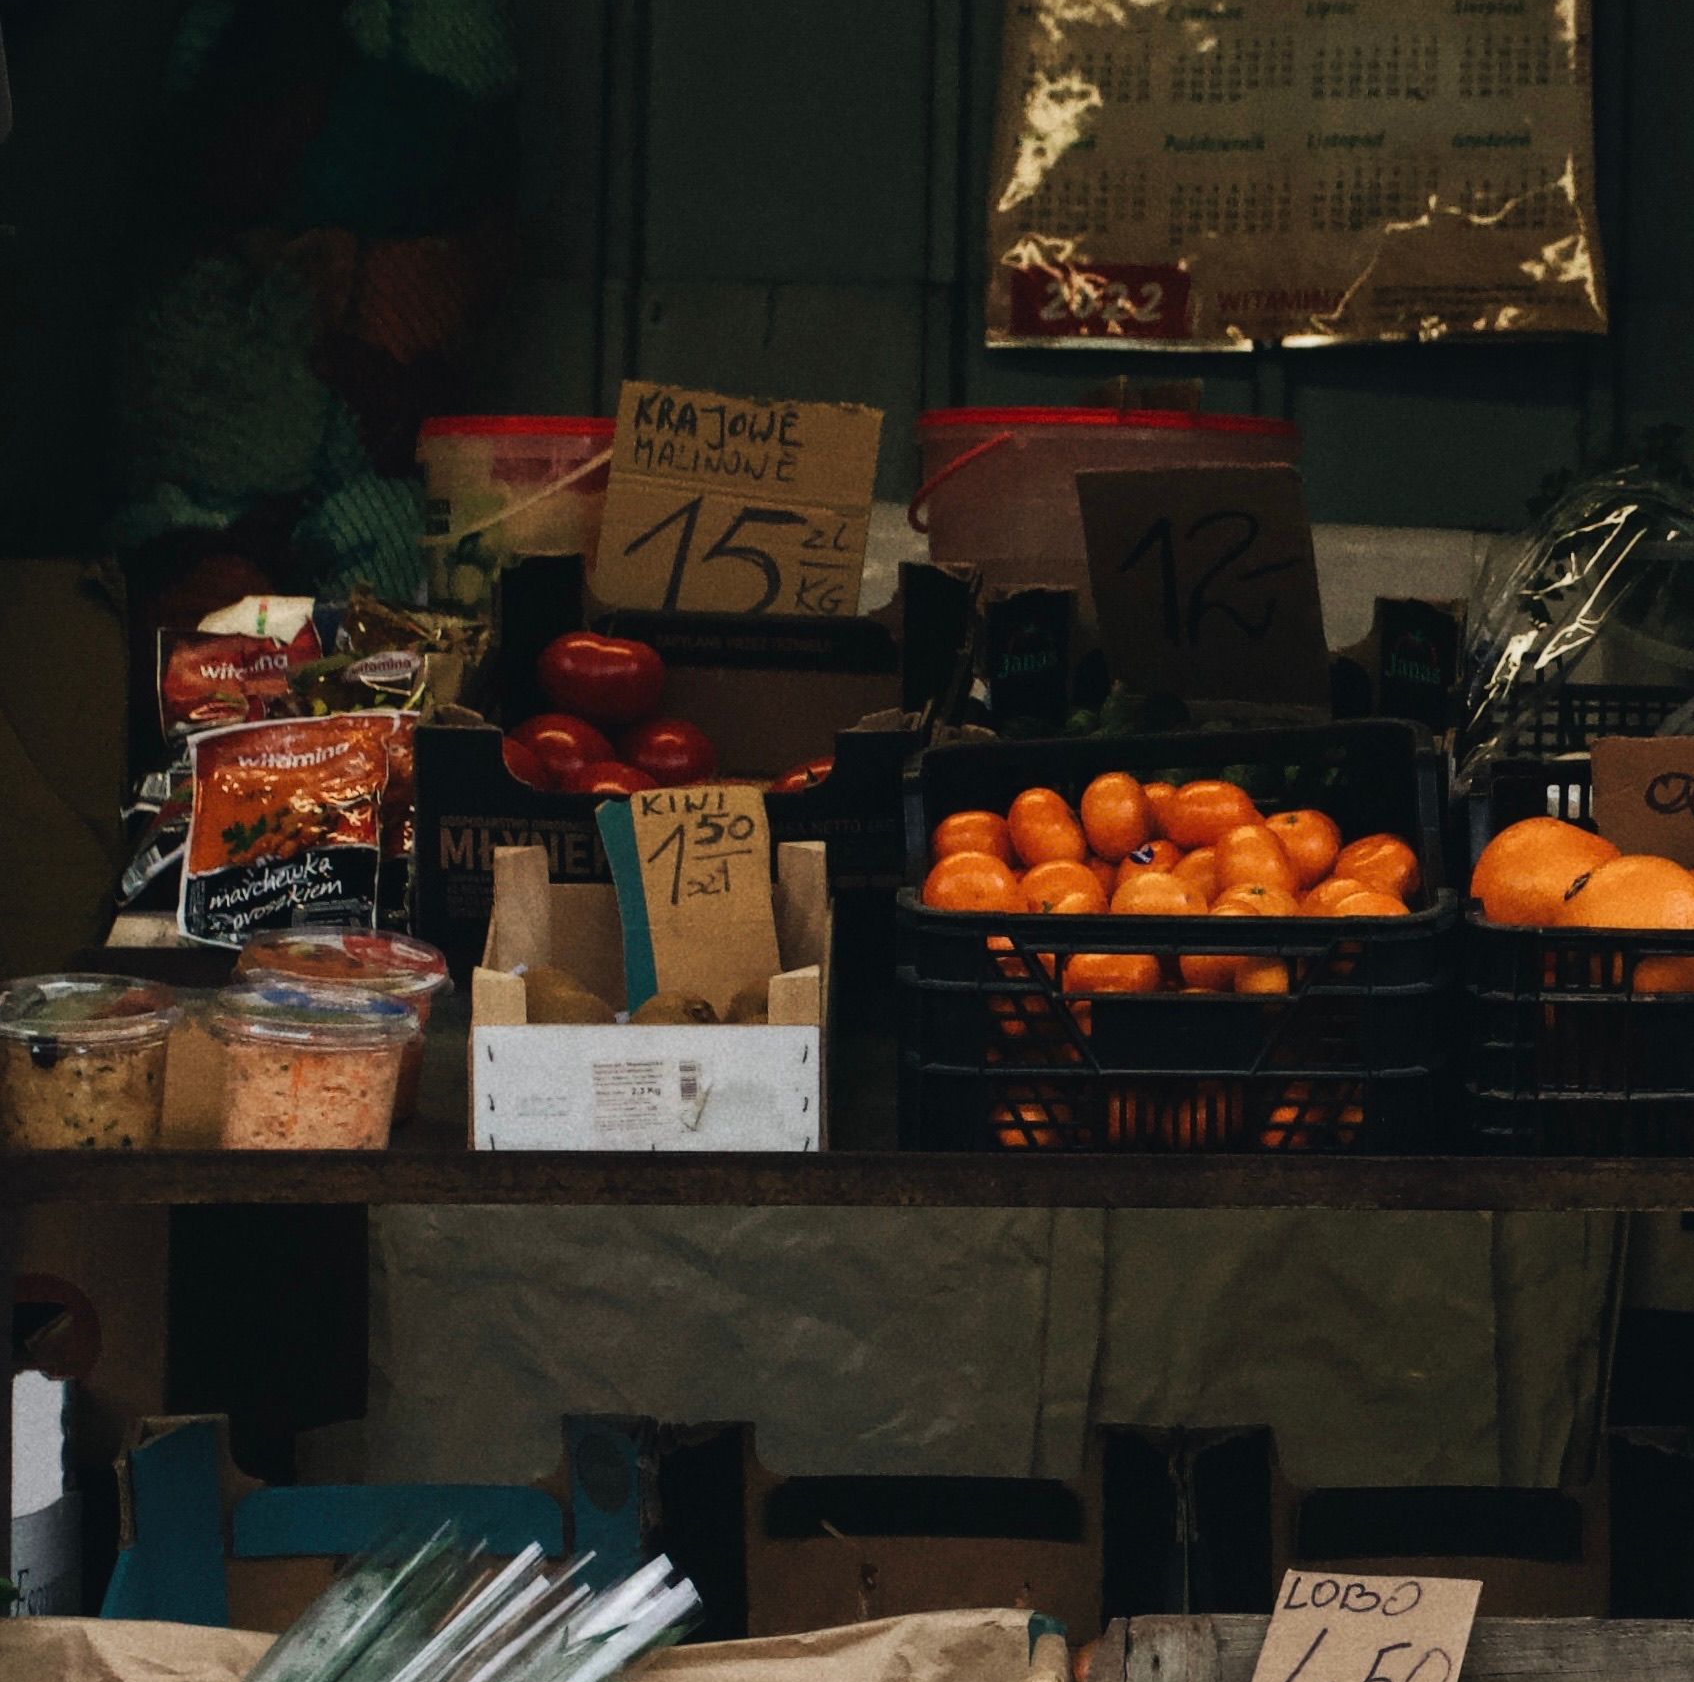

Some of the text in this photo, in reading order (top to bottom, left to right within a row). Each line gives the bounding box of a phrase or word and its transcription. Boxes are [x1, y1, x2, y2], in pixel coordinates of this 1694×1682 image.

[1038, 278, 1167, 324] 2022
[623, 495, 809, 615] 15
[796, 576, 845, 613] KG
[641, 793, 730, 817] KIWI
[648, 814, 755, 906] 1 50
[1283, 1576, 1423, 1616] LOBO
